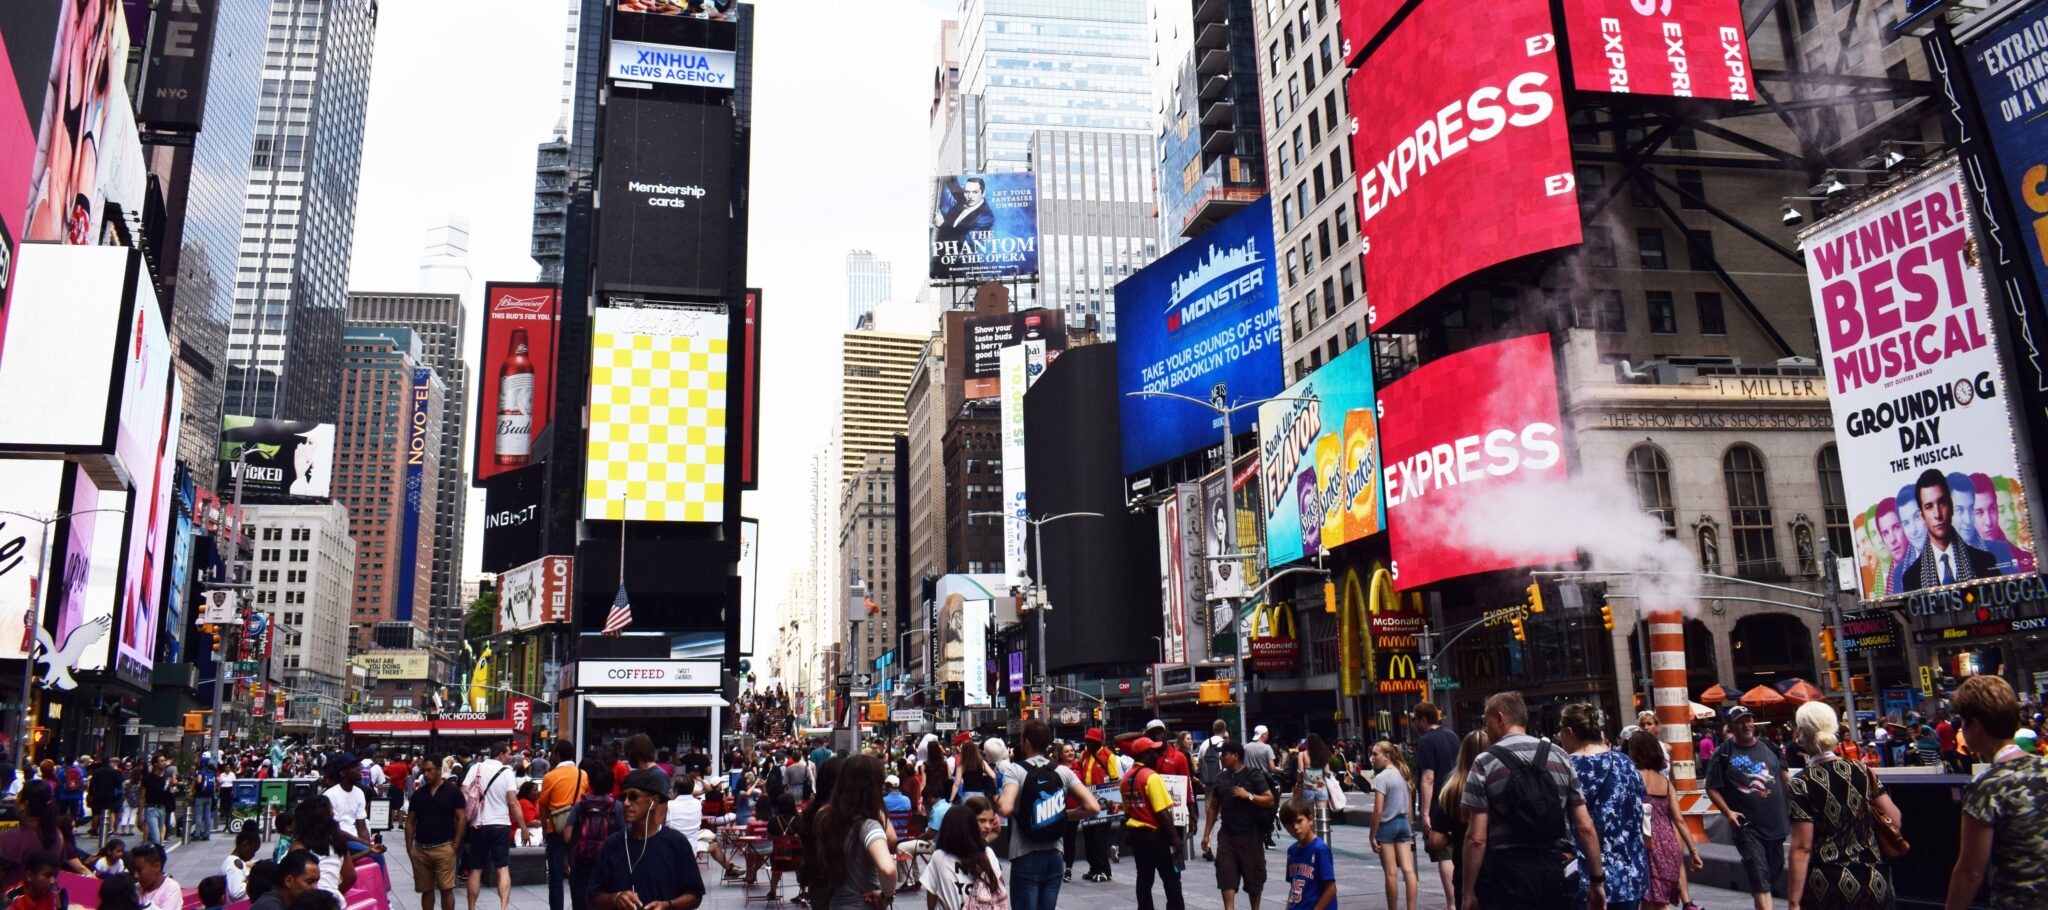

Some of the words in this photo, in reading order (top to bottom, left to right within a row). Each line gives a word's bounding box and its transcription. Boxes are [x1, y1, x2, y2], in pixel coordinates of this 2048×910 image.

[637, 50, 709, 70] XINHUA
[619, 65, 660, 80] NEWS
[665, 68, 725, 84] AGENCY
[156, 88, 188, 99] NYC
[2001, 94, 2022, 122] ON
[2022, 88, 2036, 113] A
[1361, 71, 1553, 222] EXPRESS
[628, 181, 706, 200] Membership
[991, 195, 1033, 203] FANTASIES
[1010, 189, 1032, 197] YOUR
[648, 195, 684, 208] cards
[969, 230, 996, 240] THE
[1813, 182, 1964, 281] WINNER!
[933, 237, 1036, 257] PHANTOM
[940, 255, 958, 265] OF
[959, 253, 984, 264] THE
[986, 252, 1027, 263] OPERA
[1181, 268, 1265, 325] MONSTER
[1821, 228, 1967, 353] BEST
[500, 298, 543, 310] Budweiser
[492, 312, 505, 320] THIS
[974, 326, 994, 334] Show
[995, 325, 1013, 334] your
[994, 333, 1013, 341] buds
[975, 351, 992, 360] good
[981, 342, 1003, 351] berry
[1142, 362, 1165, 384] TAKE
[1166, 346, 1193, 370] YOUR
[1194, 328, 1235, 358] SOUNDS
[1236, 319, 1253, 342] OF
[1833, 307, 1987, 394] MUSICAL
[1143, 377, 1170, 400] FROM
[1170, 353, 1225, 388] BROOKLYN
[1225, 343, 1241, 366] TO
[1241, 331, 1264, 356] LAS
[1895, 375, 1915, 387] OLIVIER
[1915, 368, 1934, 381] AWARD
[1211, 383, 1227, 399] NETS
[1741, 378, 1818, 397] MILLER
[1846, 371, 1996, 438] GROUNDHOG
[409, 379, 430, 464] NOVOTEL
[1265, 425, 1282, 462] Soak
[1293, 381, 1314, 413] Some
[1607, 413, 1633, 427] THE
[1639, 413, 1677, 428] SHOW
[1683, 413, 1727, 428] FOLKS
[1731, 413, 1765, 428] SHOE
[1771, 413, 1805, 428] SHOP
[1898, 416, 1941, 453] DAY
[1266, 394, 1321, 520] FLAVOR
[1383, 422, 1560, 509] EXPRESS
[1890, 457, 1910, 474] THE
[1914, 443, 1963, 468] MUSICAL
[1345, 439, 1375, 513] Sunkist
[1319, 454, 1343, 528] Sunkist
[552, 558, 567, 620] HELLO!
[1908, 590, 1963, 617] GIFTS
[1373, 617, 1426, 627] McDonald's
[2012, 617, 2048, 631] SONY
[1859, 633, 1891, 647] LUGGAGE
[1944, 628, 1967, 639] Nikon
[1253, 642, 1298, 650] McDonald's
[608, 669, 665, 686] COFFEED
[1920, 667, 1931, 693] ATM
[440, 712, 452, 720] NYC
[453, 712, 487, 721] HOTDOGS
[513, 702, 529, 731] tkts
[1037, 788, 1066, 825] NIKE
